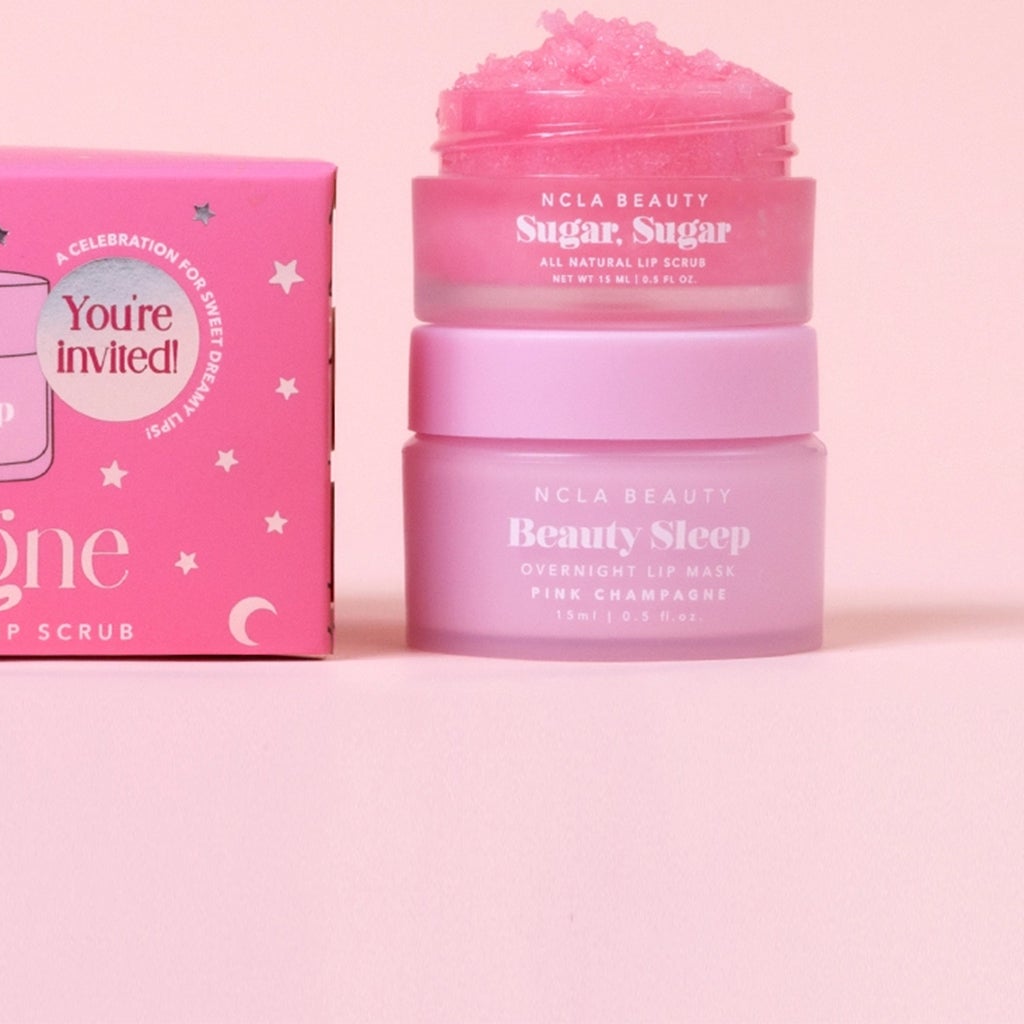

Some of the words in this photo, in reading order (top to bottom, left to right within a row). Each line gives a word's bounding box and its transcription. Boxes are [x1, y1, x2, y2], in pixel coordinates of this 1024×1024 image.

[542, 192, 604, 208] NCLA
[617, 193, 710, 208] BEAUTY
[632, 215, 732, 251] Sugar
[56, 252, 68, 266] A
[68, 233, 179, 264] CELEBRATION
[539, 257, 564, 268] ALL
[568, 257, 633, 268] NATURAL
[637, 257, 659, 268] LIP
[663, 257, 707, 269] SCRUB
[178, 259, 207, 291] FOR
[552, 275, 573, 284] NET
[577, 275, 594, 284] WT
[598, 275, 611, 284] 15
[615, 275, 631, 284] ML
[642, 275, 660, 284] 0.5
[663, 275, 675, 284] FL
[62, 294, 173, 331] You're
[201, 291, 224, 347] SWEET
[57, 339, 179, 374] invited!
[182, 350, 223, 417] DREAMY
[145, 412, 184, 441] LIPS!
[534, 487, 609, 504] NCLA
[624, 488, 732, 505] BEAUTY
[507, 517, 643, 558] Beauty
[650, 520, 751, 556] Sleep
[520, 562, 637, 578] OVERNIGHT
[647, 565, 677, 578] LIP
[685, 564, 737, 577] MASK
[531, 586, 582, 601] PINK
[594, 588, 727, 601] CHAMPAGNE
[556, 609, 598, 621] 15ml
[621, 610, 651, 623] 0.5
[37, 623, 135, 641] SCRUB
